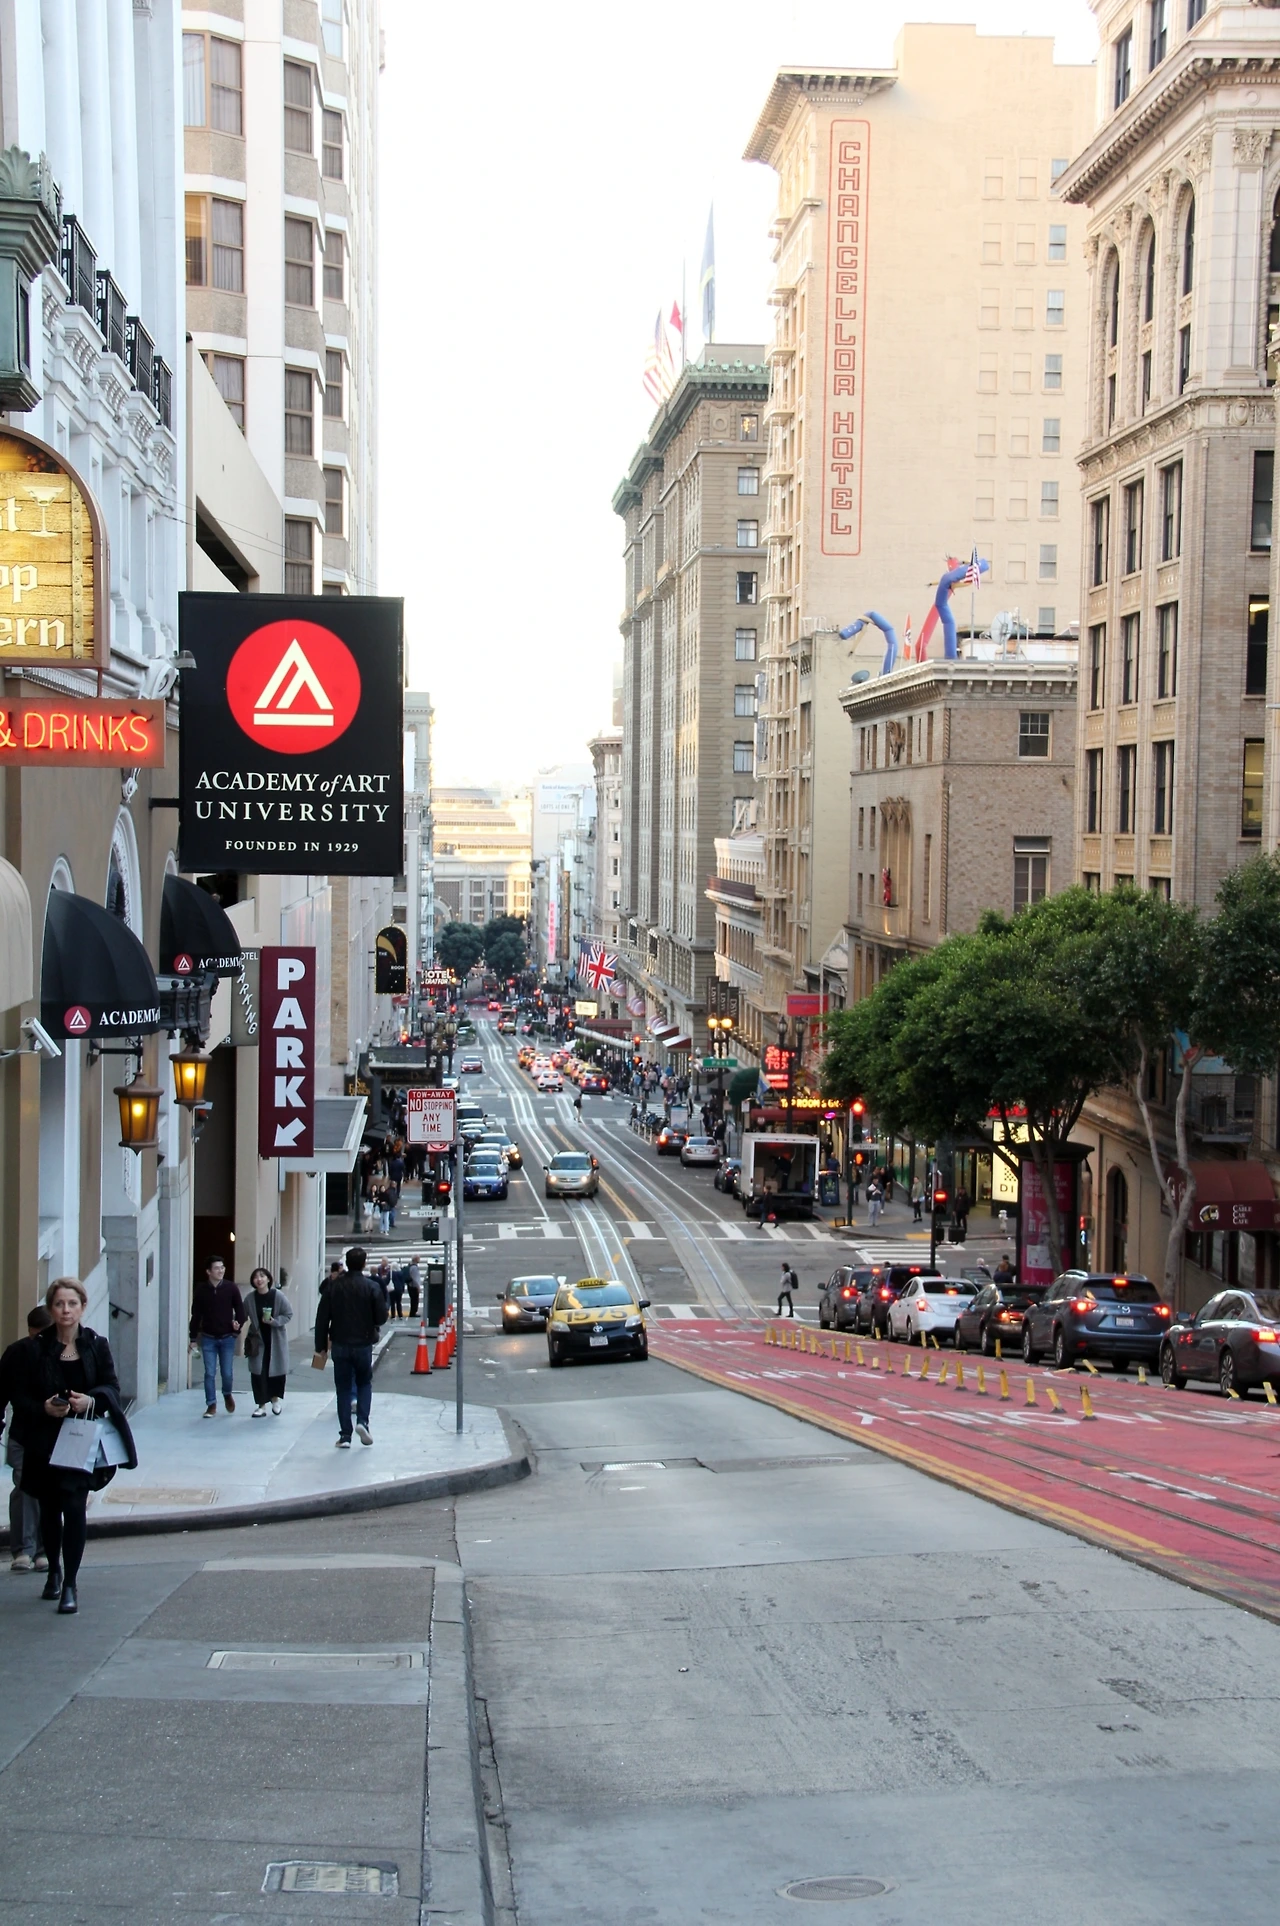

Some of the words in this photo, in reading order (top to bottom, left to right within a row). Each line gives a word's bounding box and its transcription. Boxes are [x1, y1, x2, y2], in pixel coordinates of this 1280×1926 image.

[833, 141, 862, 396] CHANCELLOR
[830, 411, 854, 536] HOTEL
[23, 712, 150, 752] DRINKS
[195, 771, 320, 792] ACADEMY
[320, 774, 343, 797] of
[340, 774, 391, 793] ART
[194, 800, 390, 823] UNIVERSITY
[225, 840, 297, 851] FOUNDED
[304, 842, 320, 851] IN
[328, 843, 359, 852] 1929
[421, 968, 451, 979] HOTEL
[99, 1008, 155, 1026] ACADEMY
[272, 958, 307, 1108] PARK
[410, 1098, 422, 1111] NO
[423, 1101, 453, 1111] STOPPING
[422, 1113, 441, 1122] ANY
[422, 1123, 442, 1133] TIME
[1232, 1204, 1252, 1213] CABLE
[579, 1279, 604, 1287] YELLOW
[564, 1308, 628, 1322] 1575
